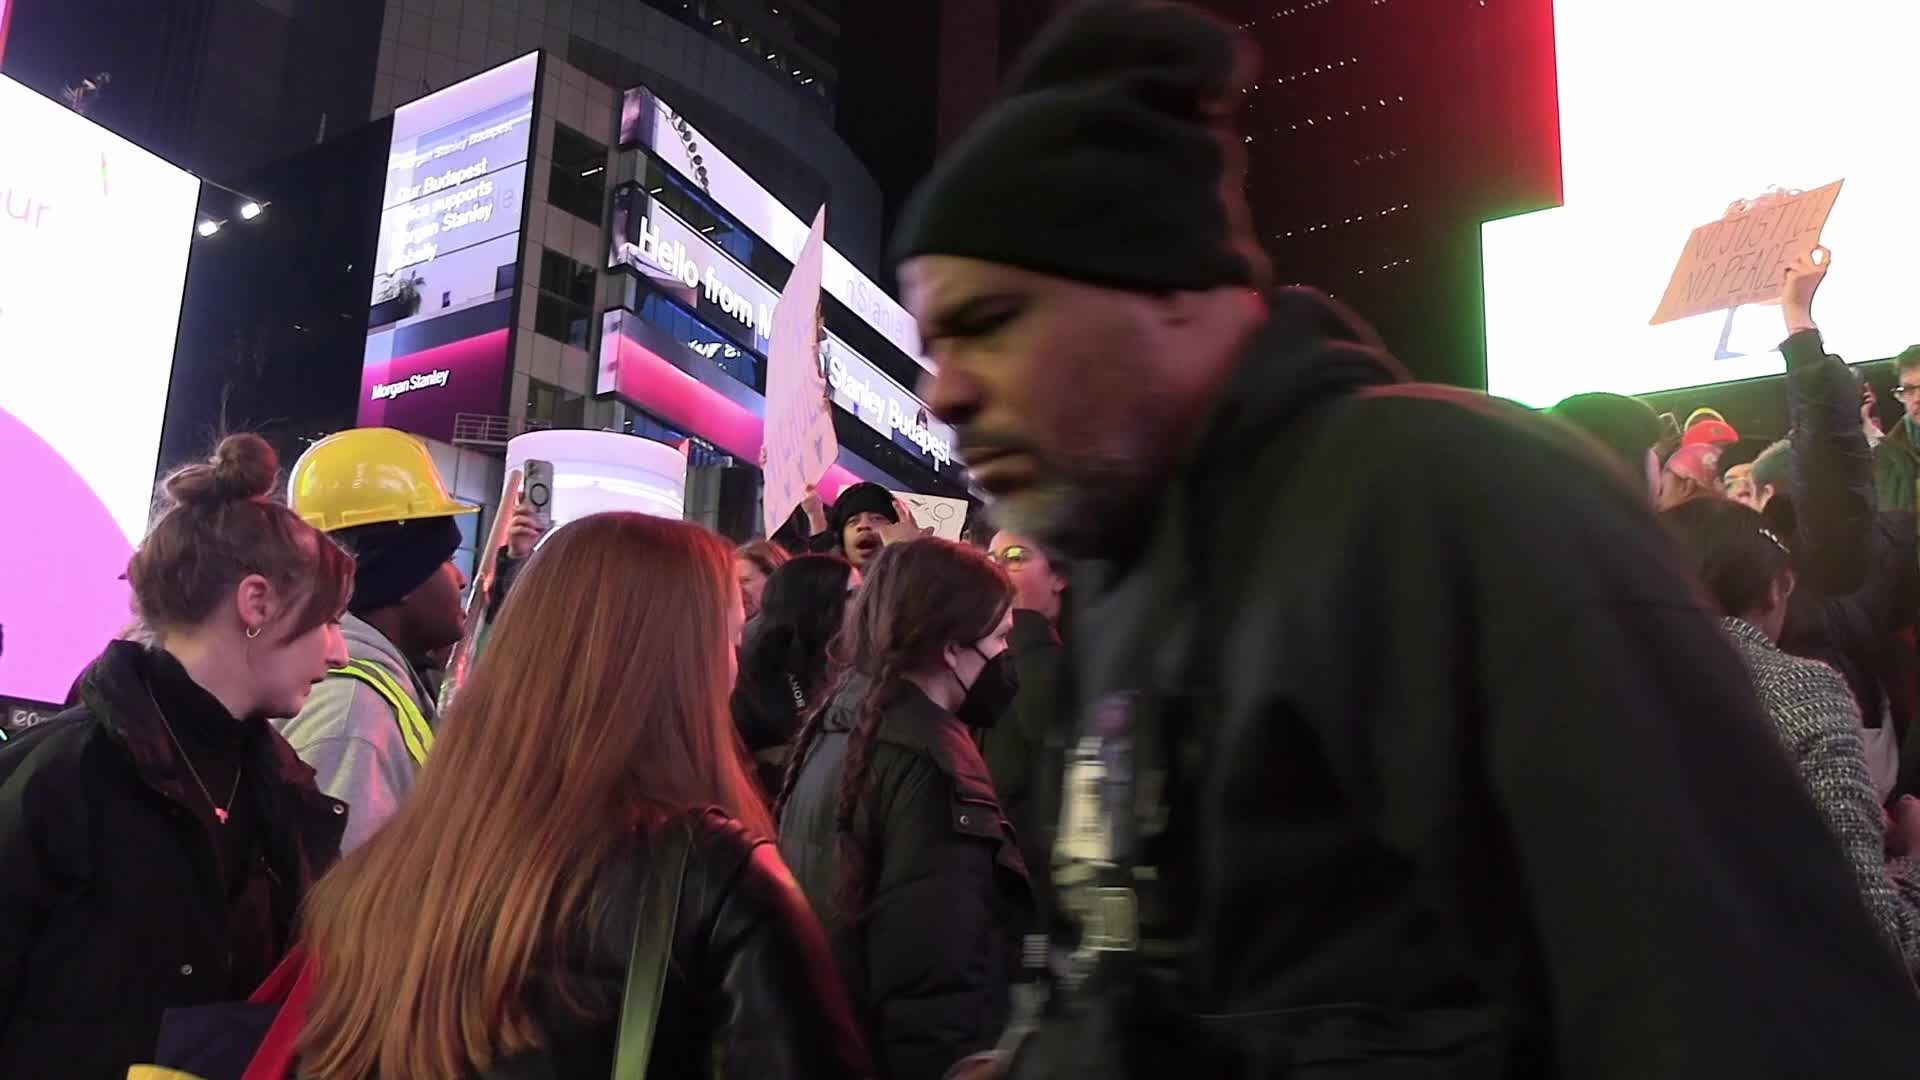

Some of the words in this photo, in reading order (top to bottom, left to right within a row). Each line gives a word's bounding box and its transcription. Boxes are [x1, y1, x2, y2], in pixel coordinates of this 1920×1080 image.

[424, 156, 488, 194] Budapest
[0, 186, 52, 229] ur
[441, 201, 494, 232] Stanley
[640, 215, 699, 288] Hello
[704, 265, 753, 328] from
[371, 380, 410, 401] Morgan
[410, 369, 450, 390] Stanley
[829, 354, 886, 424] Stanley
[888, 398, 951, 473] Budapest
